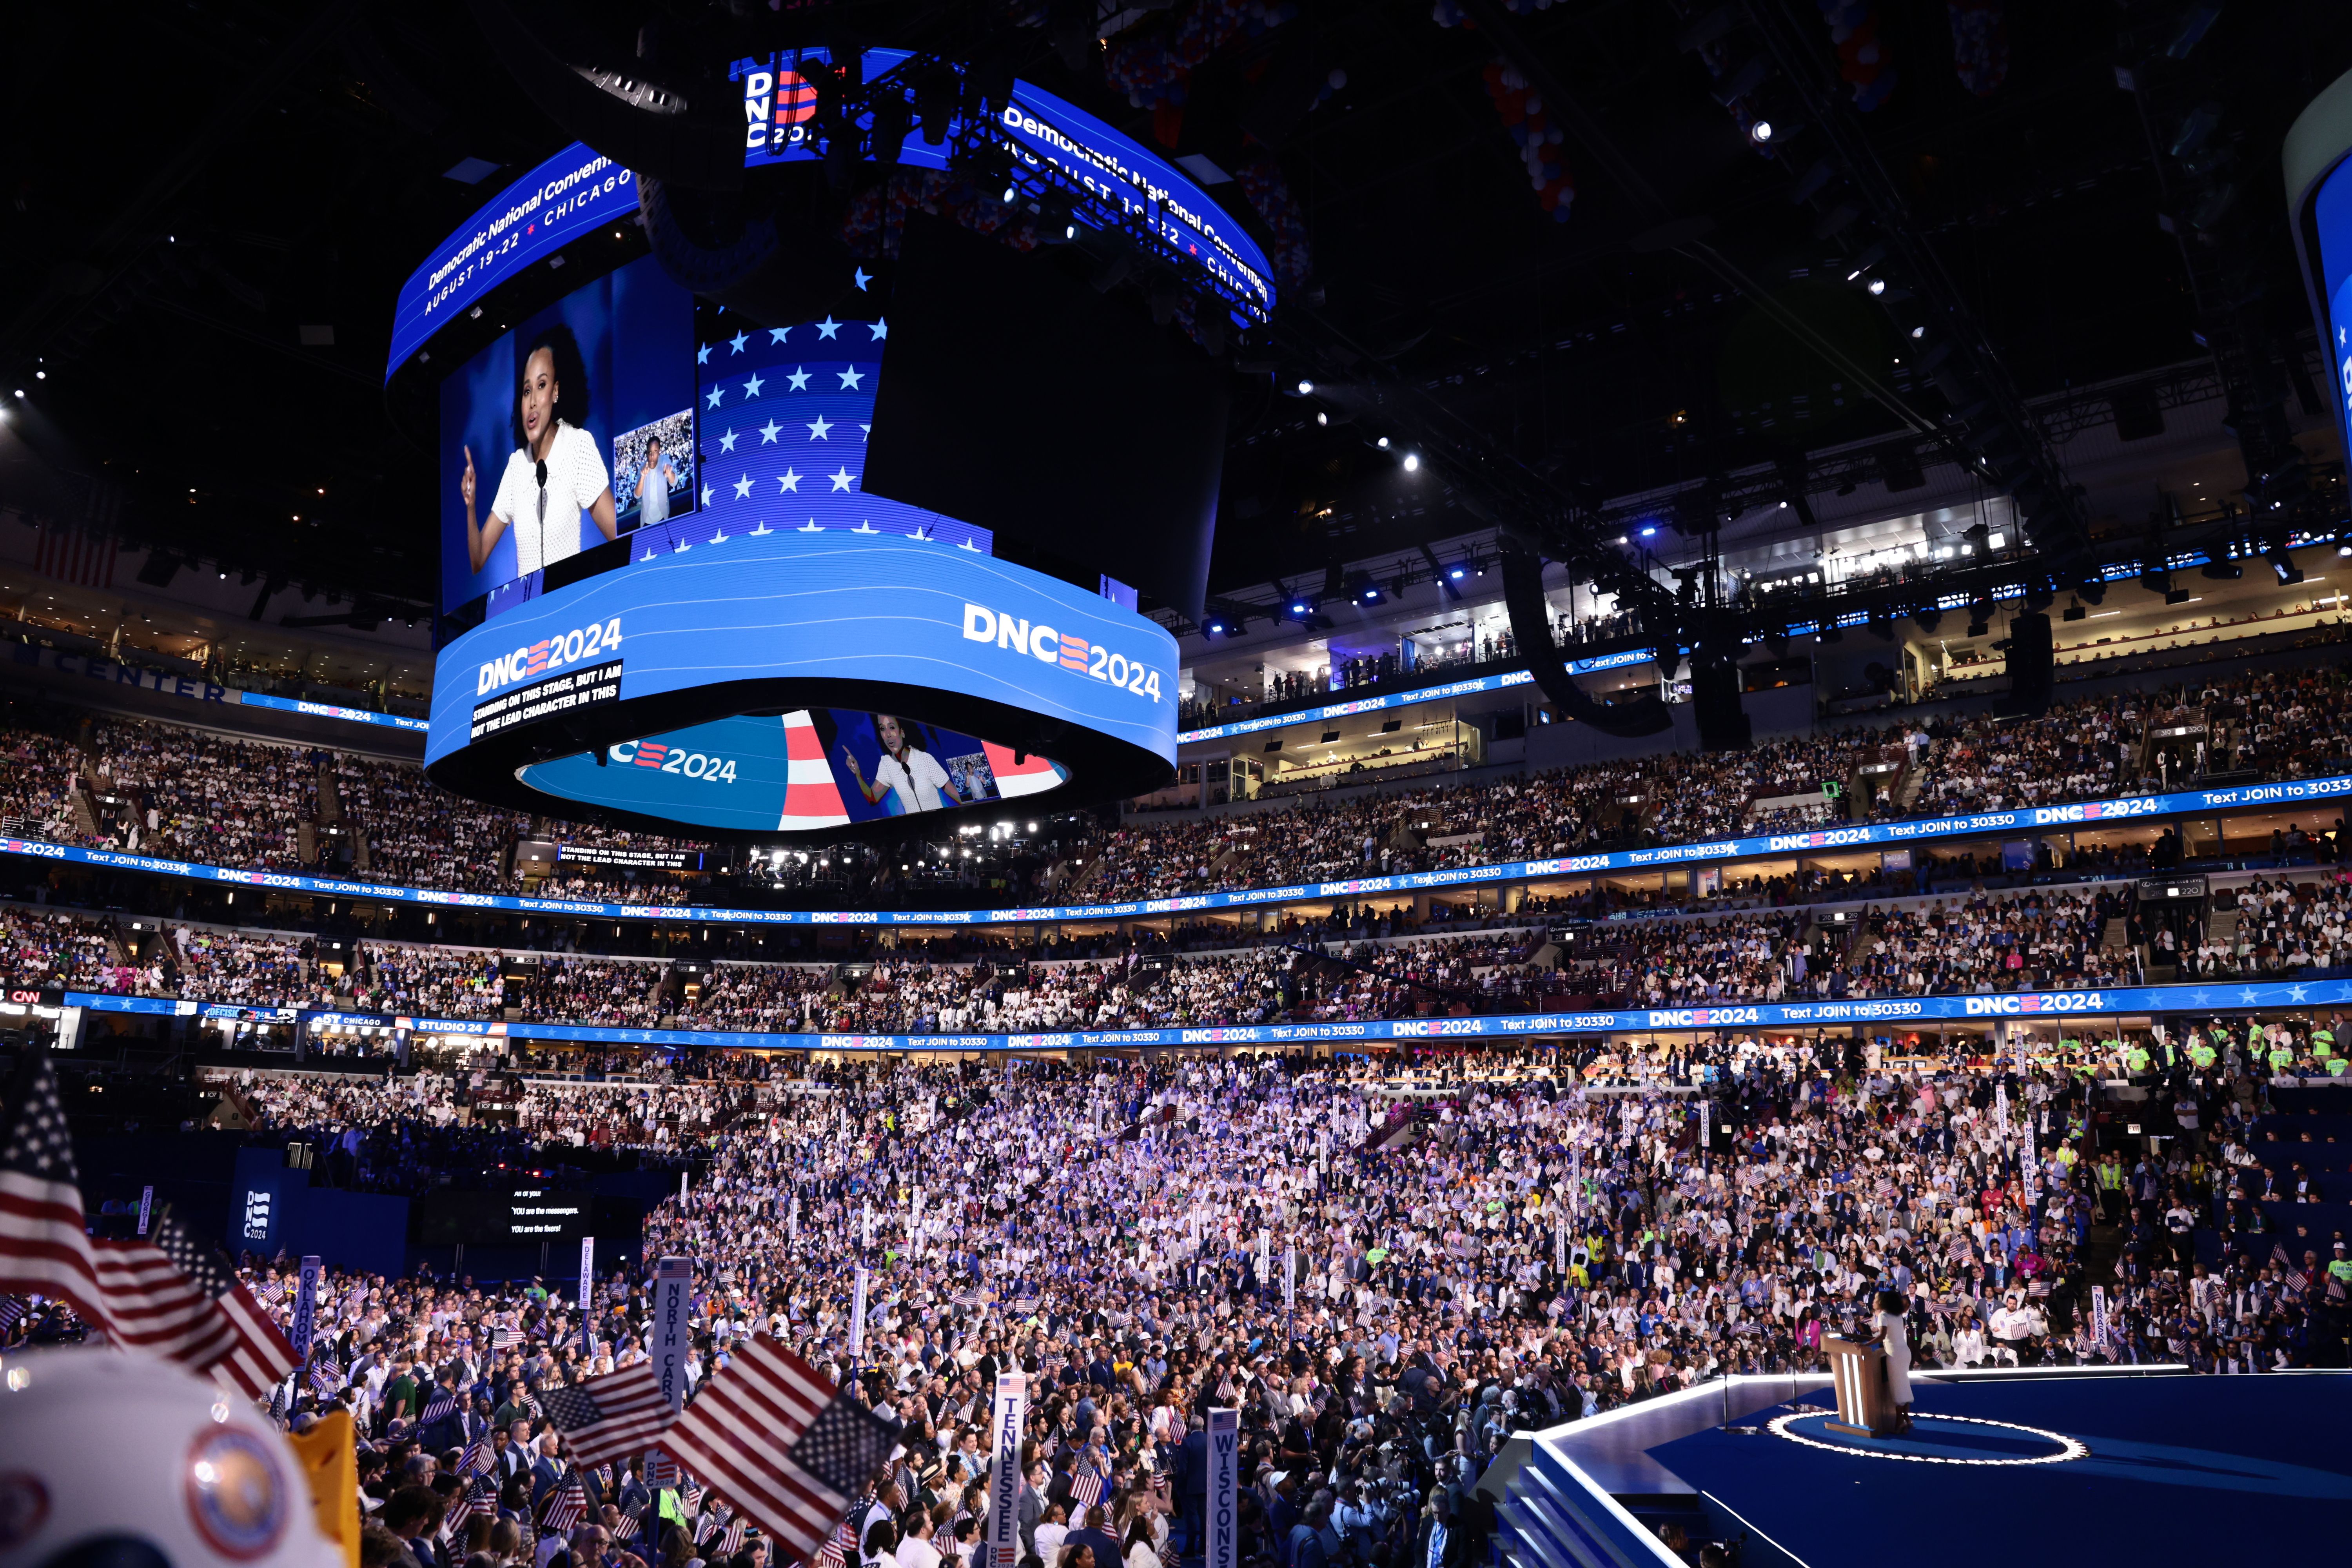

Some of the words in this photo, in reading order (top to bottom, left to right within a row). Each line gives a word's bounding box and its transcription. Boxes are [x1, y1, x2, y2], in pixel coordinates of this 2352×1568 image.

[425, 265, 474, 316] AUGUST
[480, 232, 518, 269] 19-22
[544, 169, 630, 225] CHICAGO
[428, 231, 486, 290] Democratic
[488, 188, 542, 241] National
[544, 156, 612, 201] Convent
[547, 618, 622, 669] 2024
[54, 655, 225, 705] CENTER
[473, 699, 507, 721] STANDING
[508, 694, 520, 707] ON
[522, 687, 541, 703] THIS
[542, 677, 574, 697] STAGE,
[576, 672, 597, 687] BUT
[598, 669, 603, 681] I
[605, 665, 622, 679] AM
[1089, 646, 1161, 703] 2024
[471, 723, 485, 739] NOT
[486, 718, 501, 732] THE
[501, 710, 522, 727] LEAD
[523, 694, 576, 720] CHARACTER
[578, 690, 590, 704] IN
[592, 684, 617, 701] THIS
[662, 749, 737, 784] 2024
[2203, 792, 2237, 804] Text
[2242, 787, 2282, 800] JOIN
[2287, 784, 2303, 795] to
[1888, 825, 1915, 836] Text
[1918, 821, 1952, 833] JOIN
[1954, 821, 1967, 829] to
[1971, 815, 2014, 828] 30330
[561, 846, 597, 855] STANDING
[613, 858, 656, 866] CHARACTER
[313, 881, 334, 889] Text
[373, 887, 404, 896] 30330
[12, 991, 40, 1003] CNN
[1781, 1008, 1811, 1018] Text
[1817, 1006, 1850, 1017] JOIN
[1854, 1005, 1870, 1016] to
[1872, 1003, 1921, 1016] 30330
[343, 1017, 381, 1025] CHICAGO
[418, 1021, 466, 1032] STUDIO
[467, 1024, 483, 1033] 24
[1272, 1028, 1295, 1038] Text
[1296, 1028, 1317, 1036] JOIN
[1332, 1026, 1364, 1035] 30330
[2023, 1155, 2033, 1197] MAINE
[140, 1191, 151, 1227] GEORGIA
[250, 1230, 266, 1240] 2024
[296, 1269, 314, 1357] OKLAHOMA
[665, 1284, 680, 1347] NORTH
[2095, 1294, 2105, 1345] NEBRASKA
[662, 1354, 675, 1405] CARO
[646, 1462, 655, 1487] DNC
[998, 1397, 1018, 1542] TENNESSEE
[1215, 1434, 1234, 1567] WISCONS
